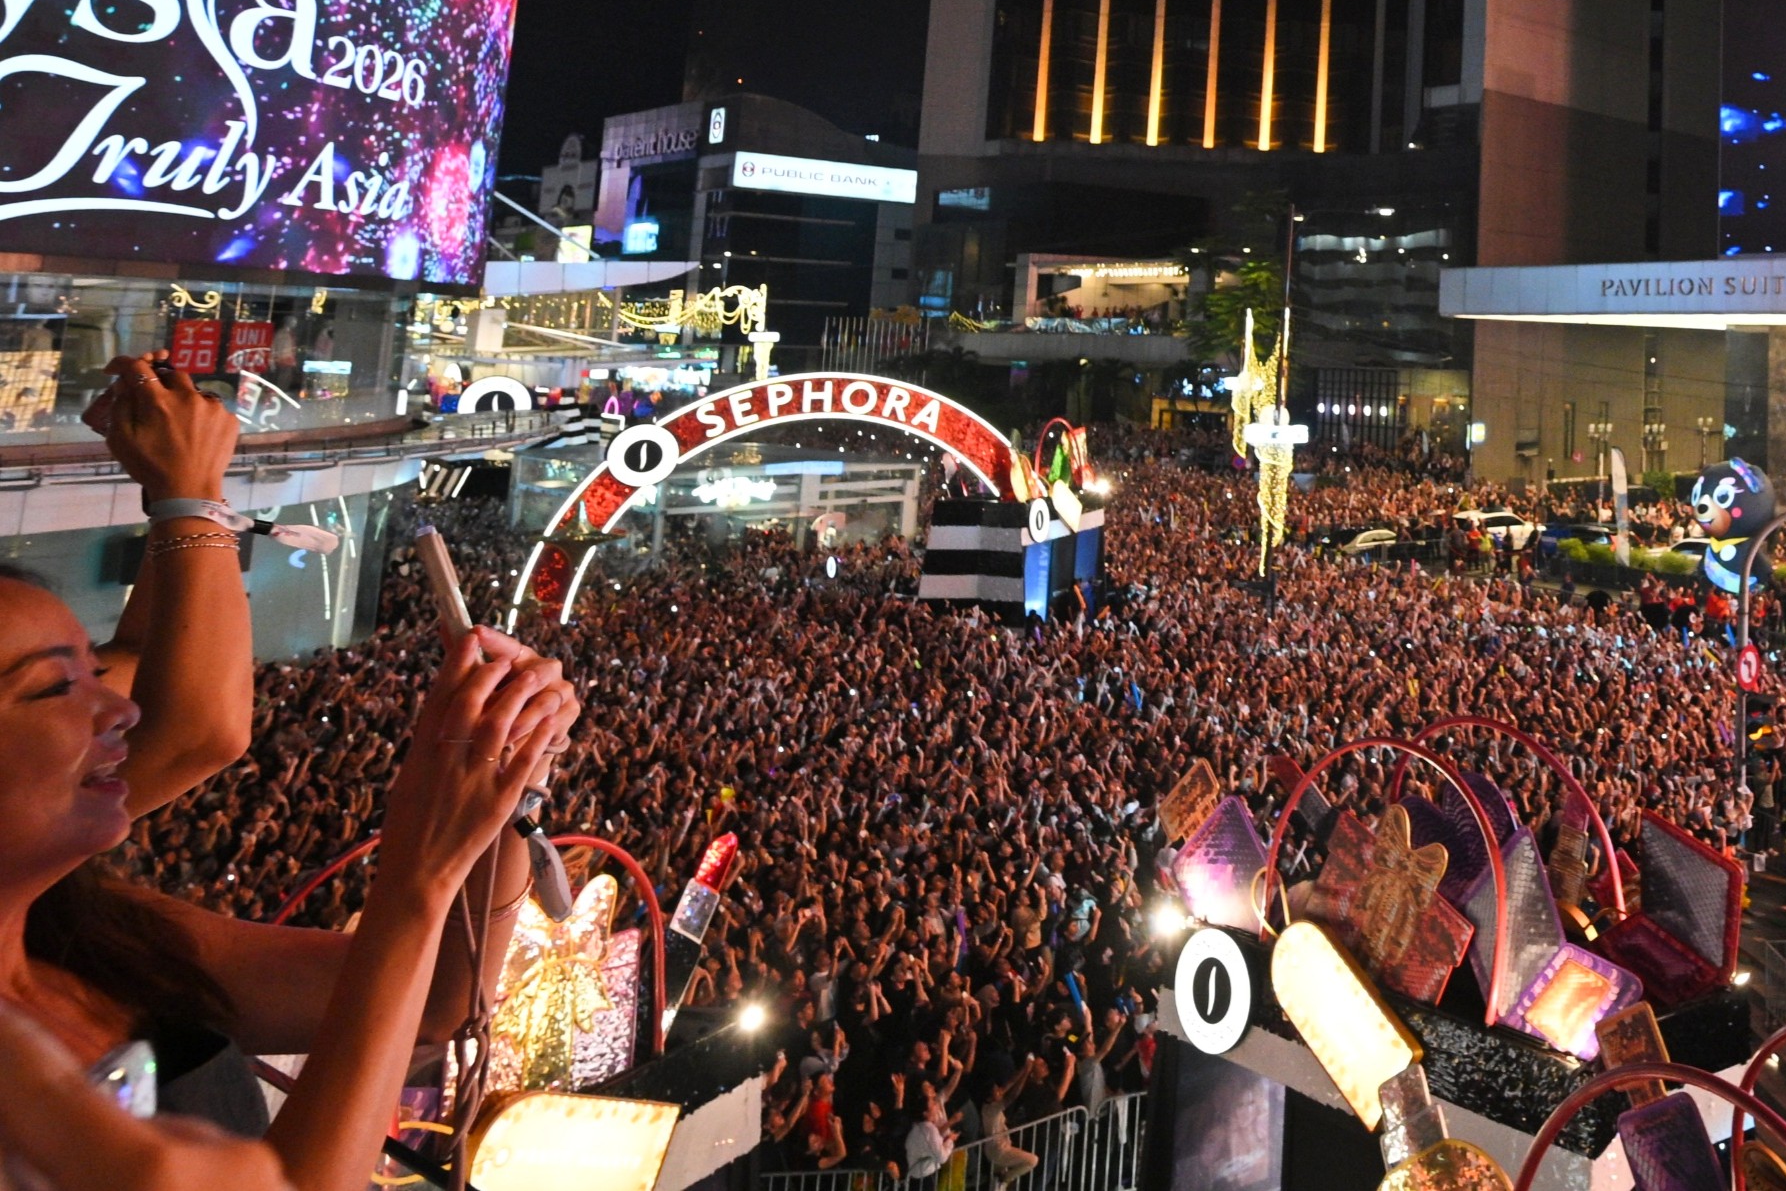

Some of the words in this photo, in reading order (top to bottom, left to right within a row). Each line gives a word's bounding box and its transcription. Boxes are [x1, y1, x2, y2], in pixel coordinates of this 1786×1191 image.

[321, 35, 427, 109] 2026
[284, 139, 414, 222] Asia
[762, 166, 825, 181] PUBLIC
[830, 174, 878, 187] BANK
[1601, 276, 1714, 298] PAVILION
[236, 328, 268, 345] UNI
[695, 379, 941, 440] SEPHORA
